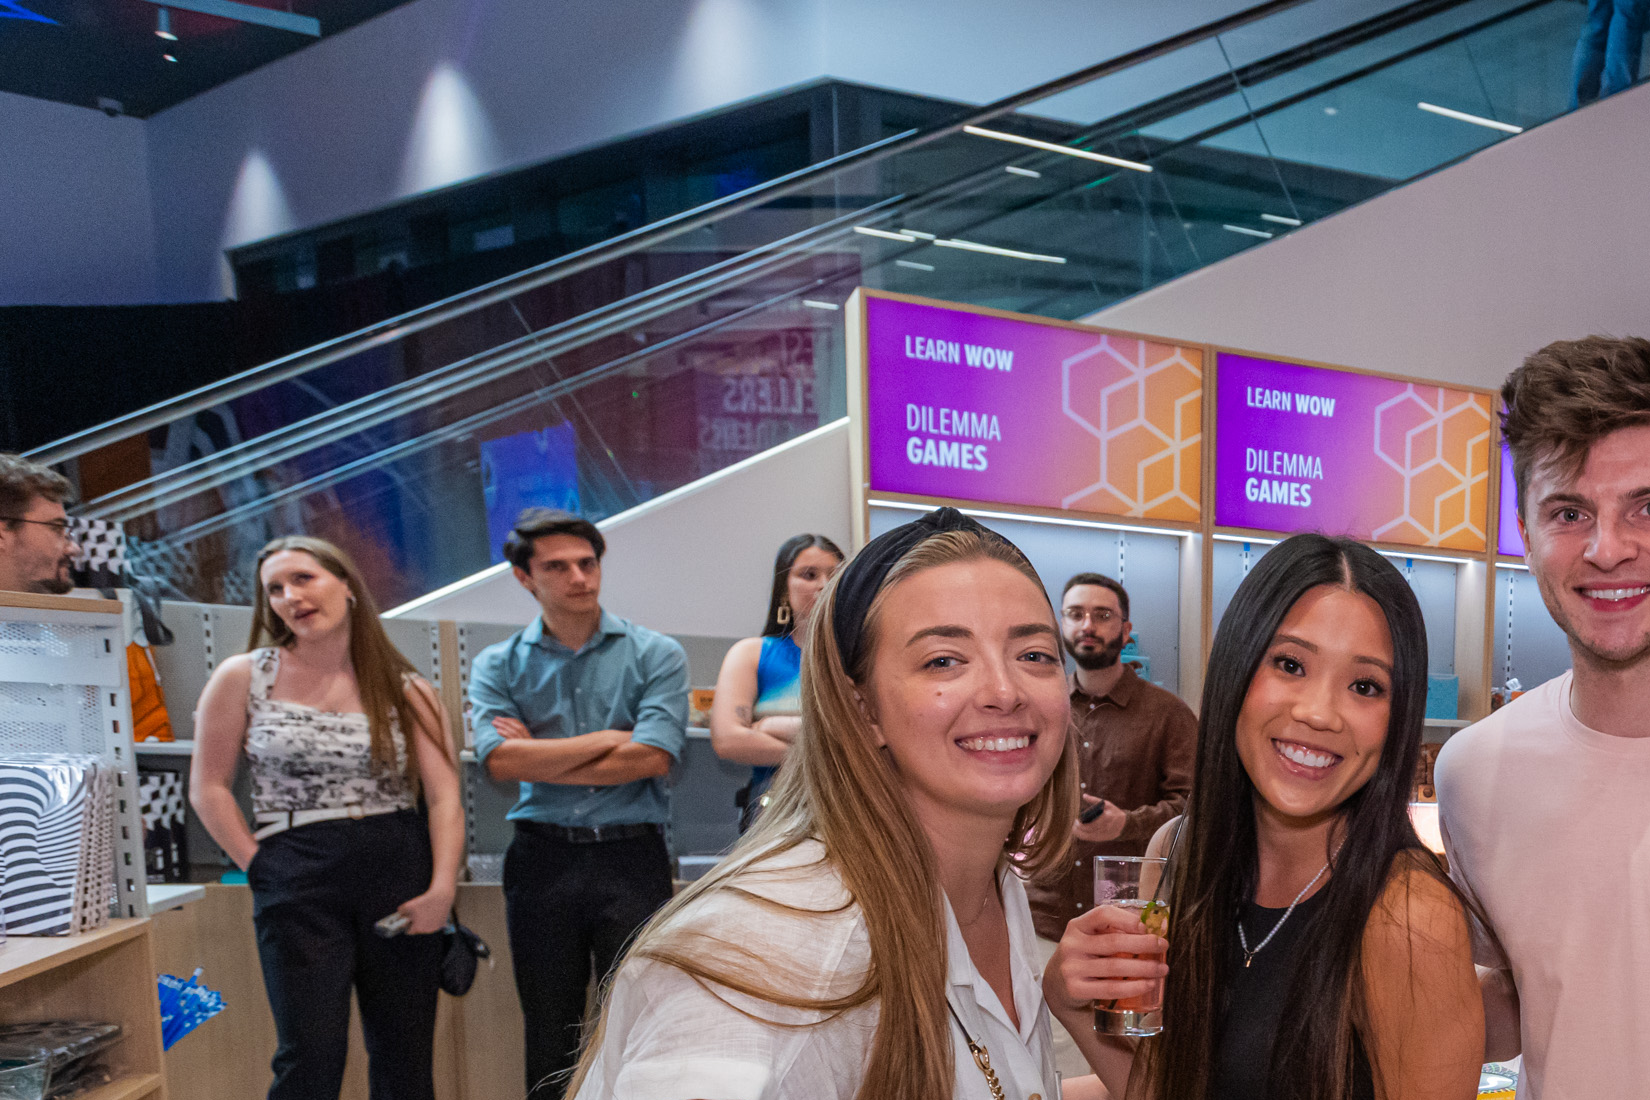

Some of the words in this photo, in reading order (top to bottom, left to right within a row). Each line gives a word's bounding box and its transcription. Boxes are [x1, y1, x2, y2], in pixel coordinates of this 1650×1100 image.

[905, 335, 960, 365] LEARN
[964, 344, 1014, 373] WOW
[1246, 386, 1291, 412] LEARN
[1295, 393, 1336, 418] WOW
[906, 403, 1001, 441] DILEMMA
[906, 436, 989, 472] GAMES
[1246, 448, 1324, 480] DILEMMA
[1245, 477, 1312, 508] GAMES
